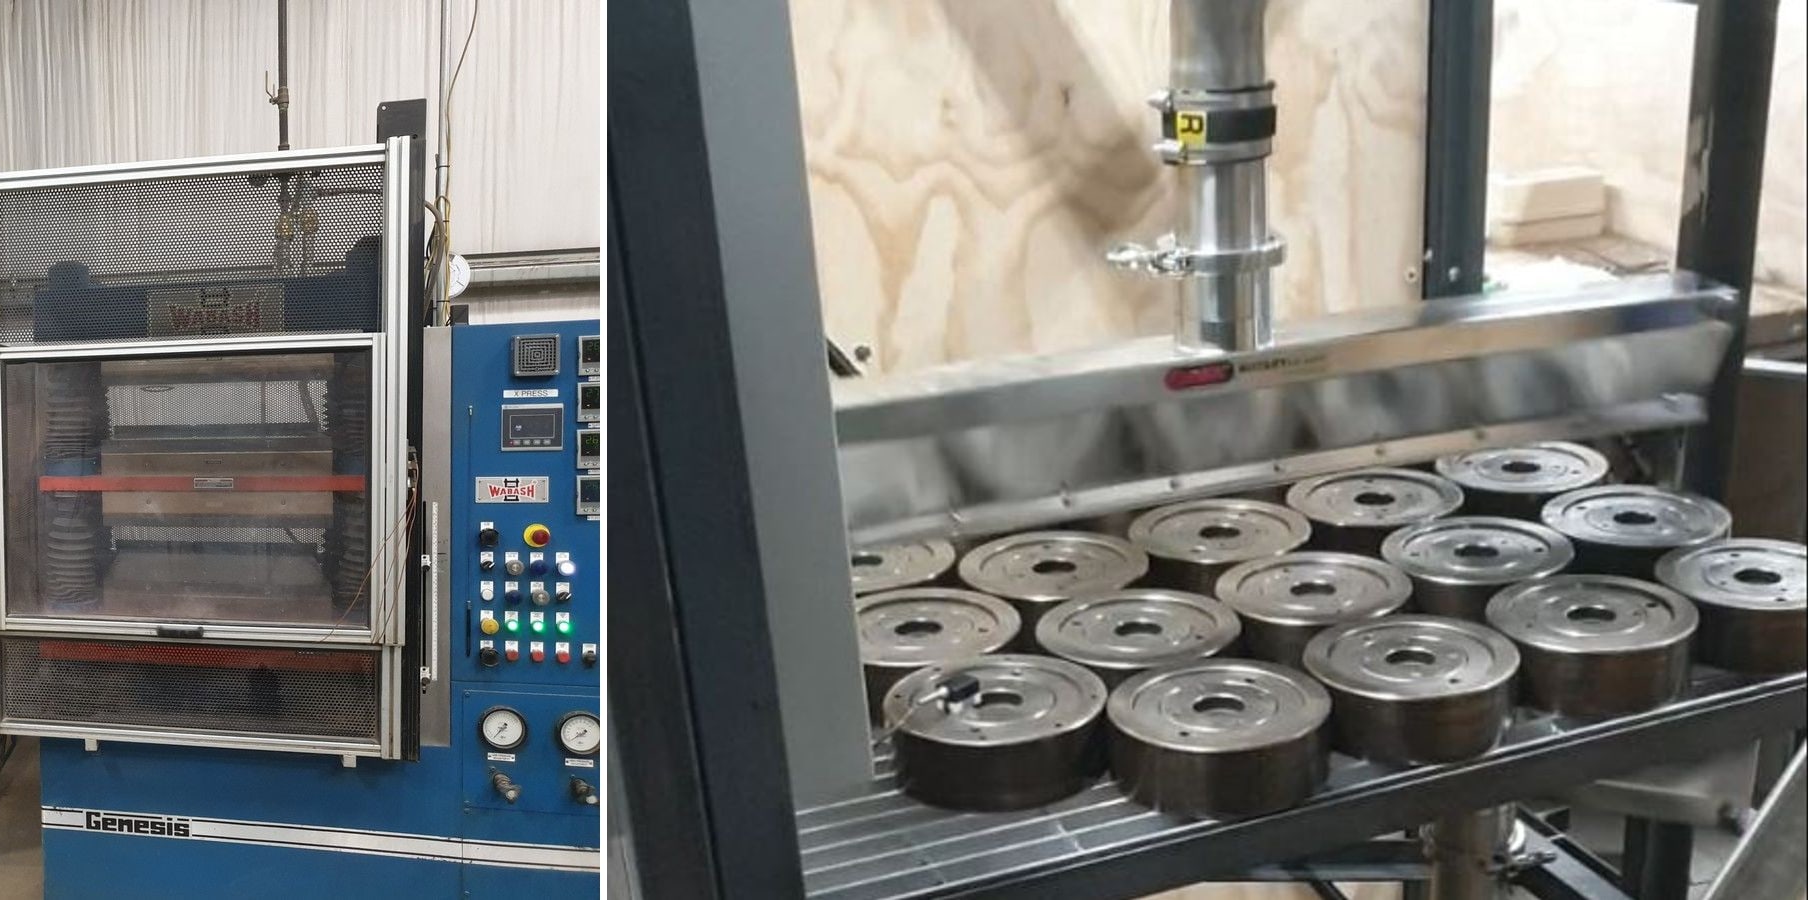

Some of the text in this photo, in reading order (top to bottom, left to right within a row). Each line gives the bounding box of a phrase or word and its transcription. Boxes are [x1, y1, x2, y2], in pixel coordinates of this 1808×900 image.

[1181, 114, 1203, 134] R
[489, 485, 535, 498] WABASH
[85, 811, 189, 838] Genesis
